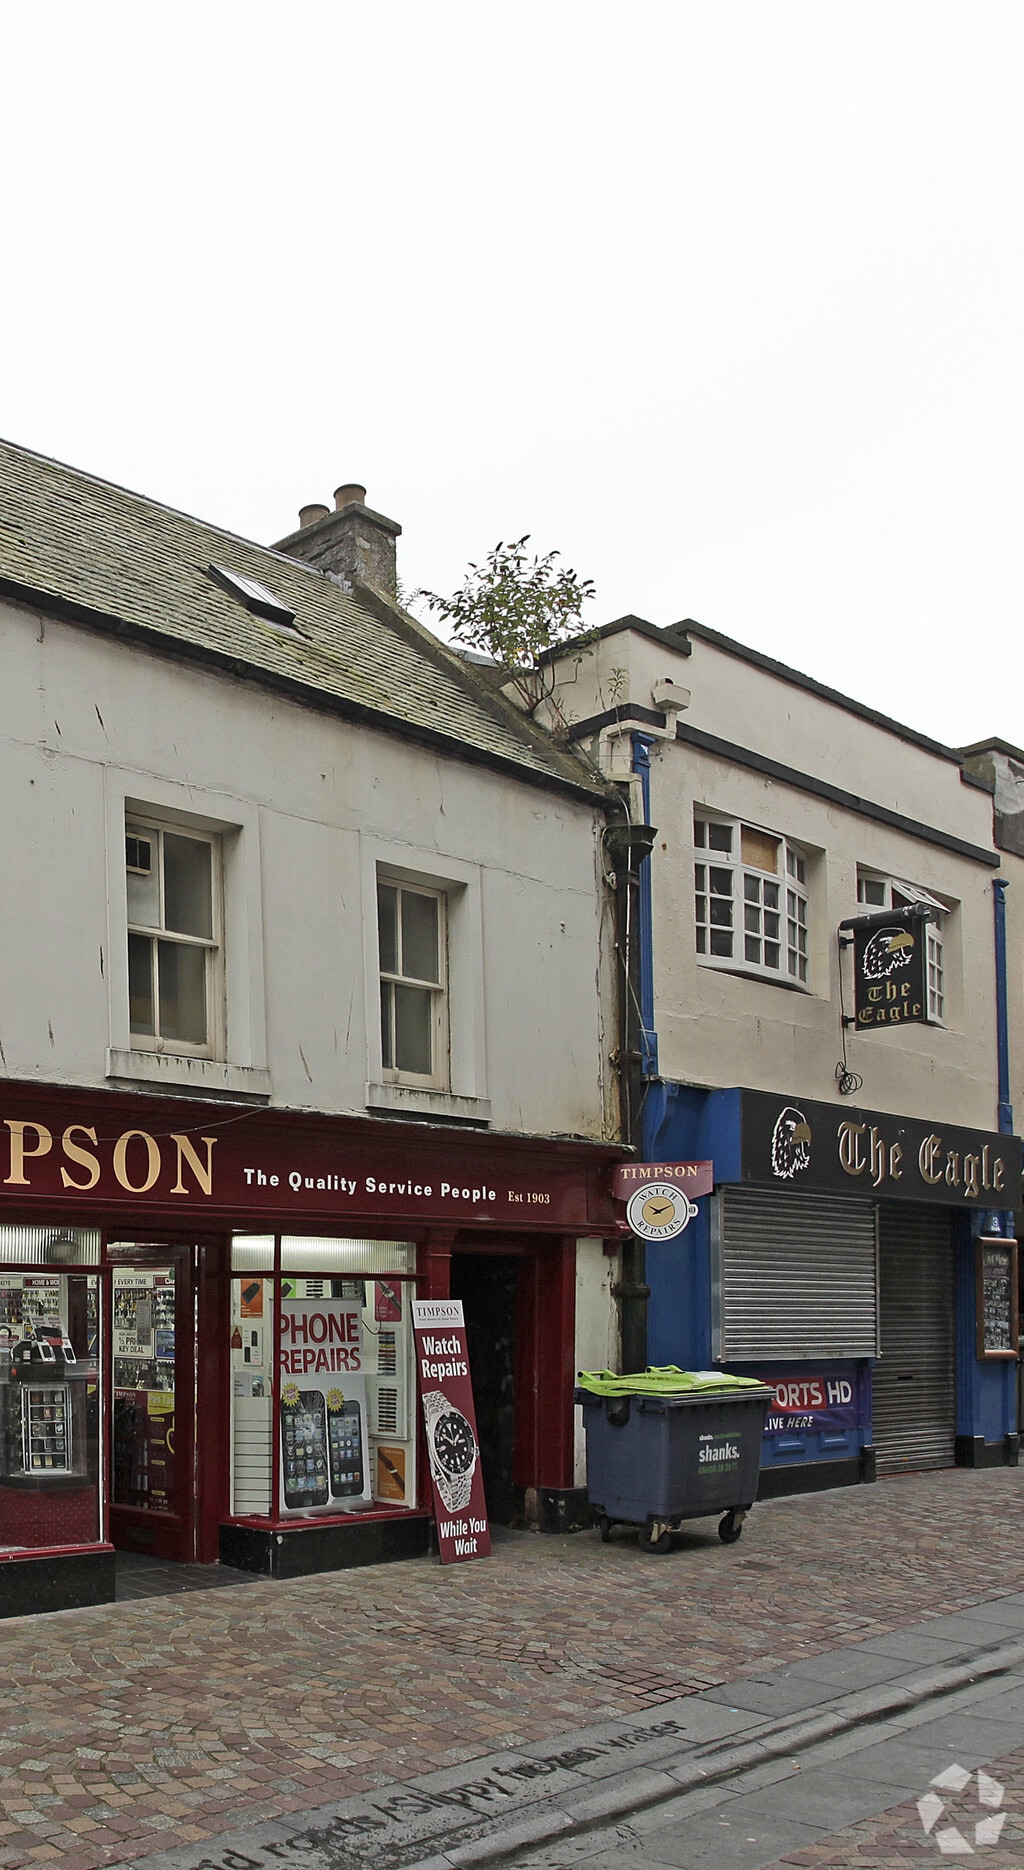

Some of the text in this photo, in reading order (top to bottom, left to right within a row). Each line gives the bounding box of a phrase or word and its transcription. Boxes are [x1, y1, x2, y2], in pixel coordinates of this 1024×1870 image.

[867, 981, 910, 1002] The
[858, 1002, 922, 1023] Eagle
[837, 1121, 1005, 1198] The Eagle
[621, 1166, 698, 1179] TIMPSON
[244, 1168, 550, 1204] The Quality Service People Est 1903
[638, 1188, 677, 1201] WATCH
[637, 1218, 681, 1235] REPAIRS
[118, 1278, 134, 1286] EVERY
[416, 1307, 459, 1317] TIMPSON
[281, 1312, 359, 1345] PHONE
[126, 1337, 136, 1345] PRI
[130, 1346, 144, 1354] DEAL
[422, 1335, 461, 1355] Watch
[281, 1346, 361, 1374] REPAIRS
[422, 1358, 467, 1382] Repairs
[773, 1381, 852, 1407] ORTS HD
[787, 1416, 814, 1428] HERE
[699, 1442, 740, 1462] shanks.
[440, 1517, 486, 1538] While You
[454, 1537, 478, 1556] Wait
